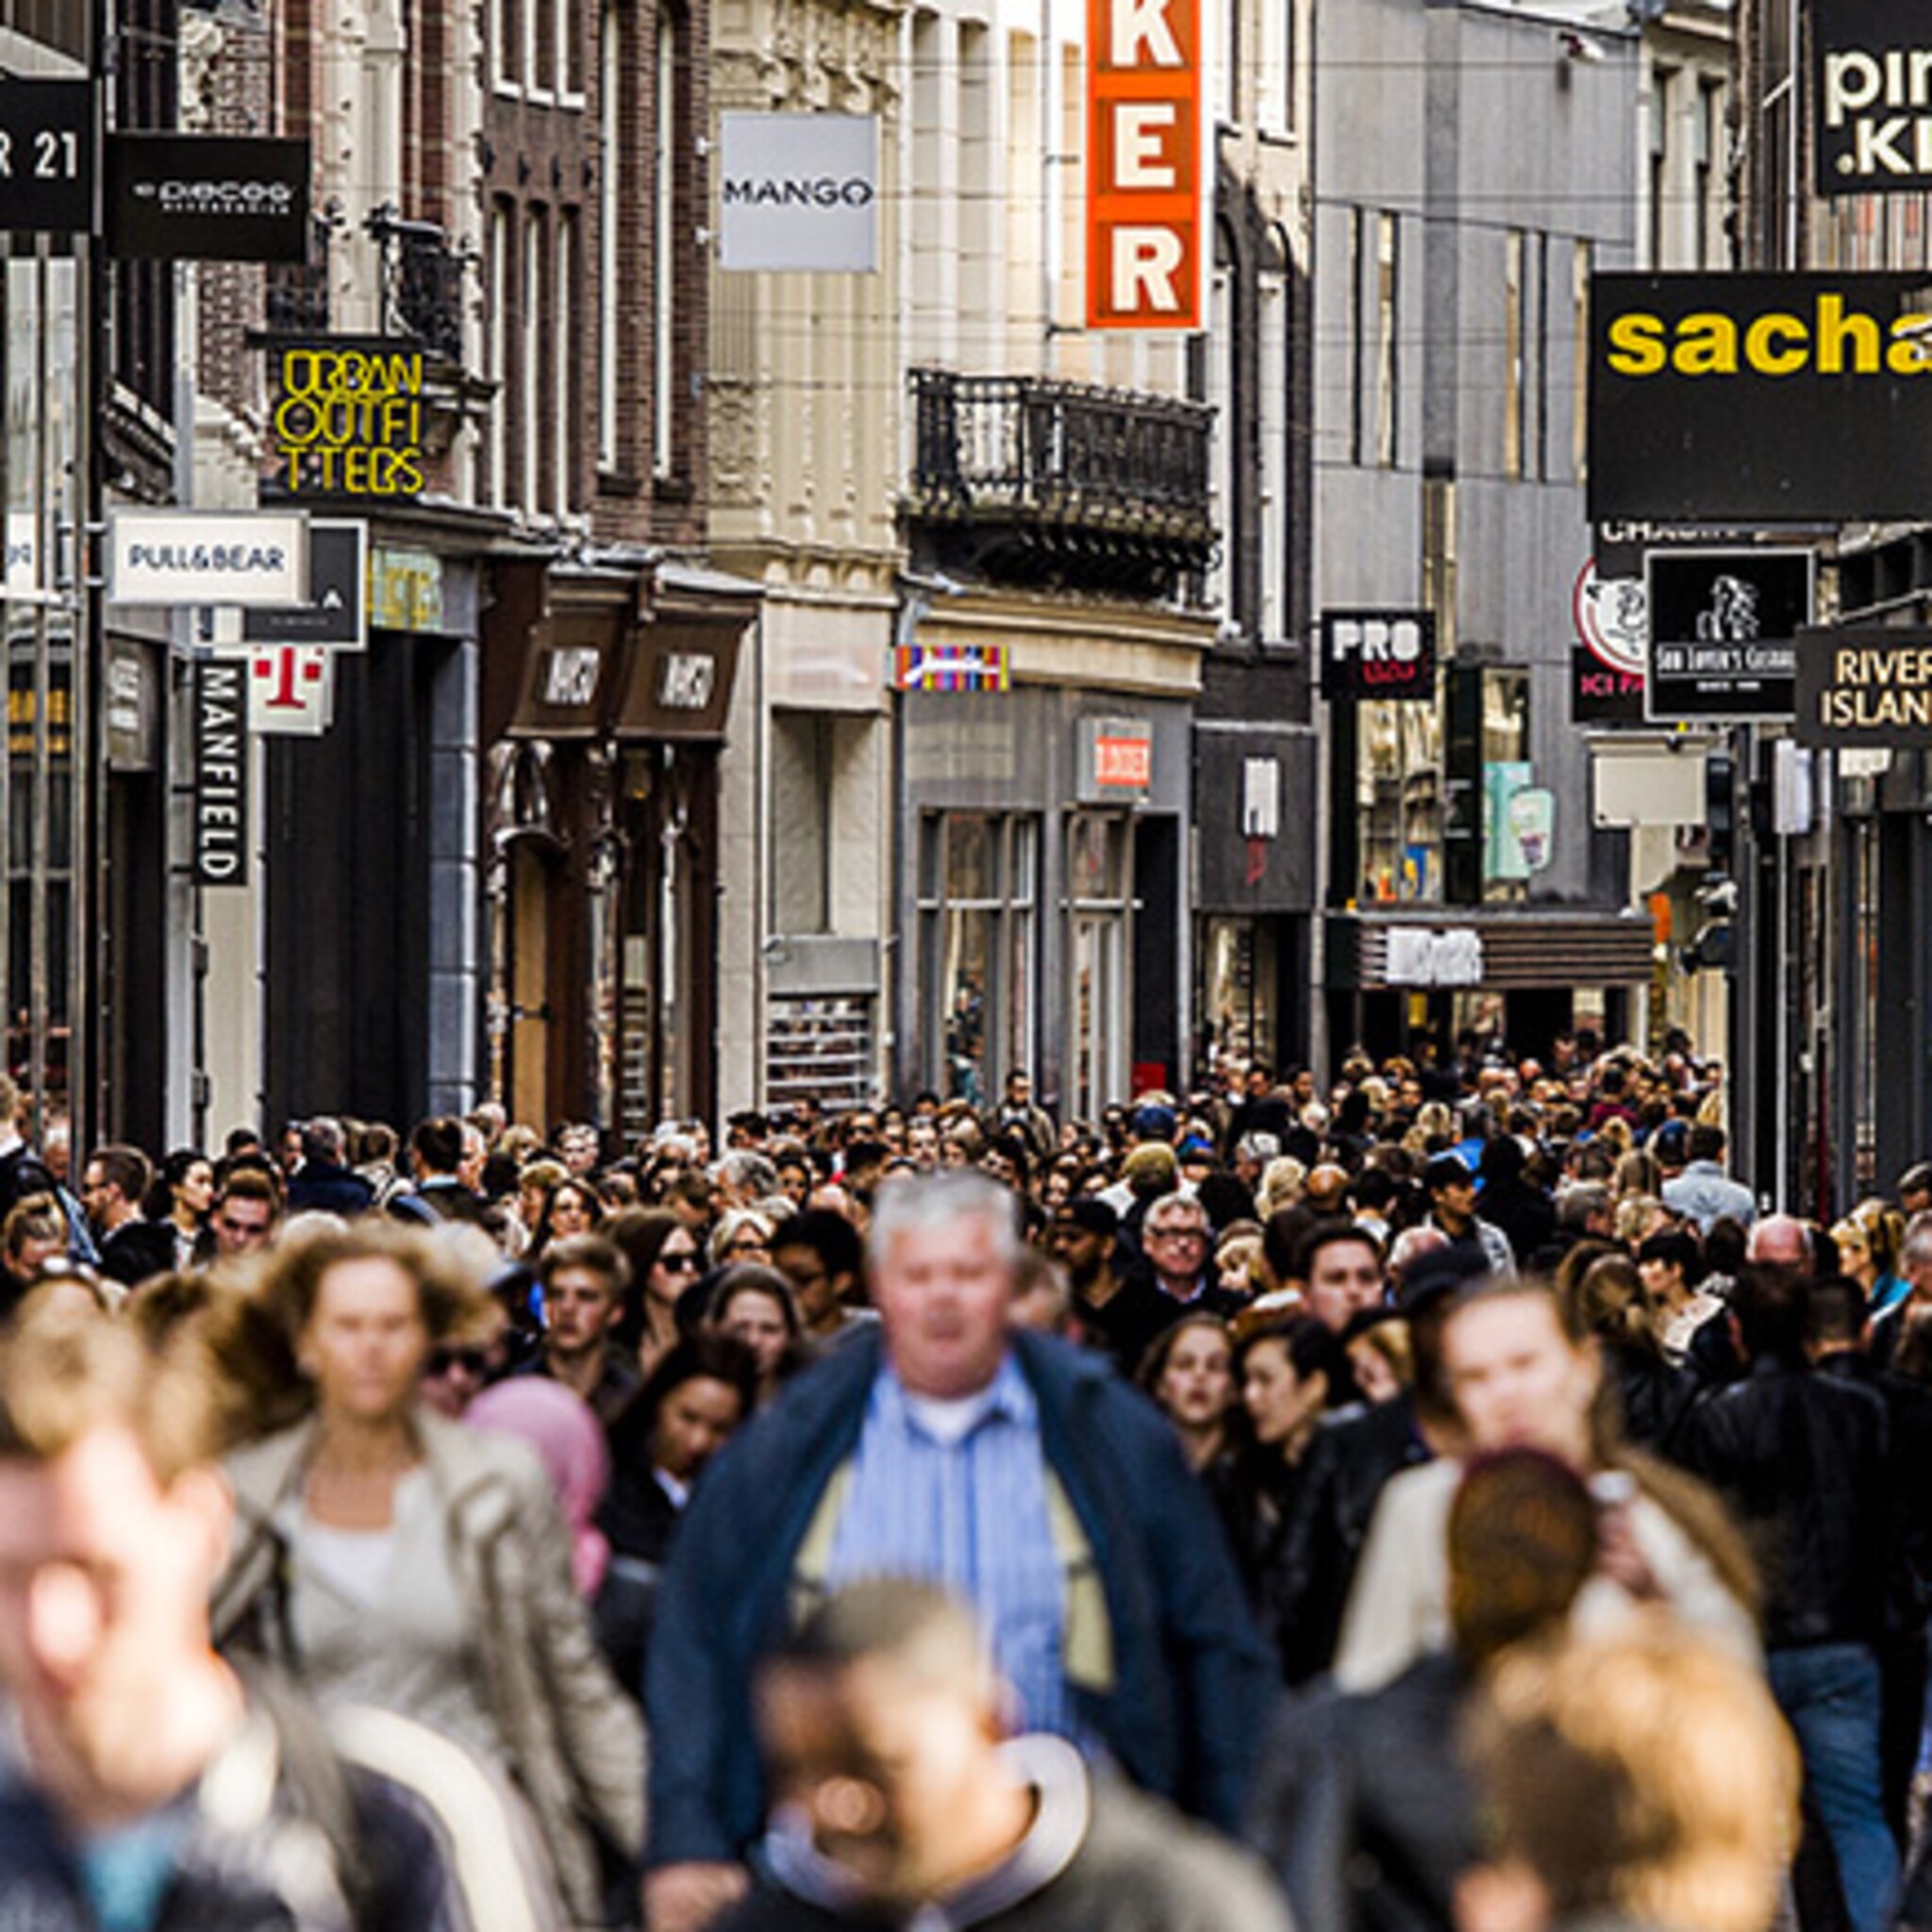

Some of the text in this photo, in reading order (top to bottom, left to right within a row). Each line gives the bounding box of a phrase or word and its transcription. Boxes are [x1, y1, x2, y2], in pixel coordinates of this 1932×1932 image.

[34, 131, 76, 178] 21
[724, 178, 874, 207] MANGO
[1607, 292, 1932, 375] sacha
[284, 349, 423, 396] URBAN
[275, 398, 420, 445] OUTFI
[128, 544, 285, 573] PULL&BEAR
[1333, 620, 1419, 660] PRO
[201, 667, 237, 876] MANFIELD
